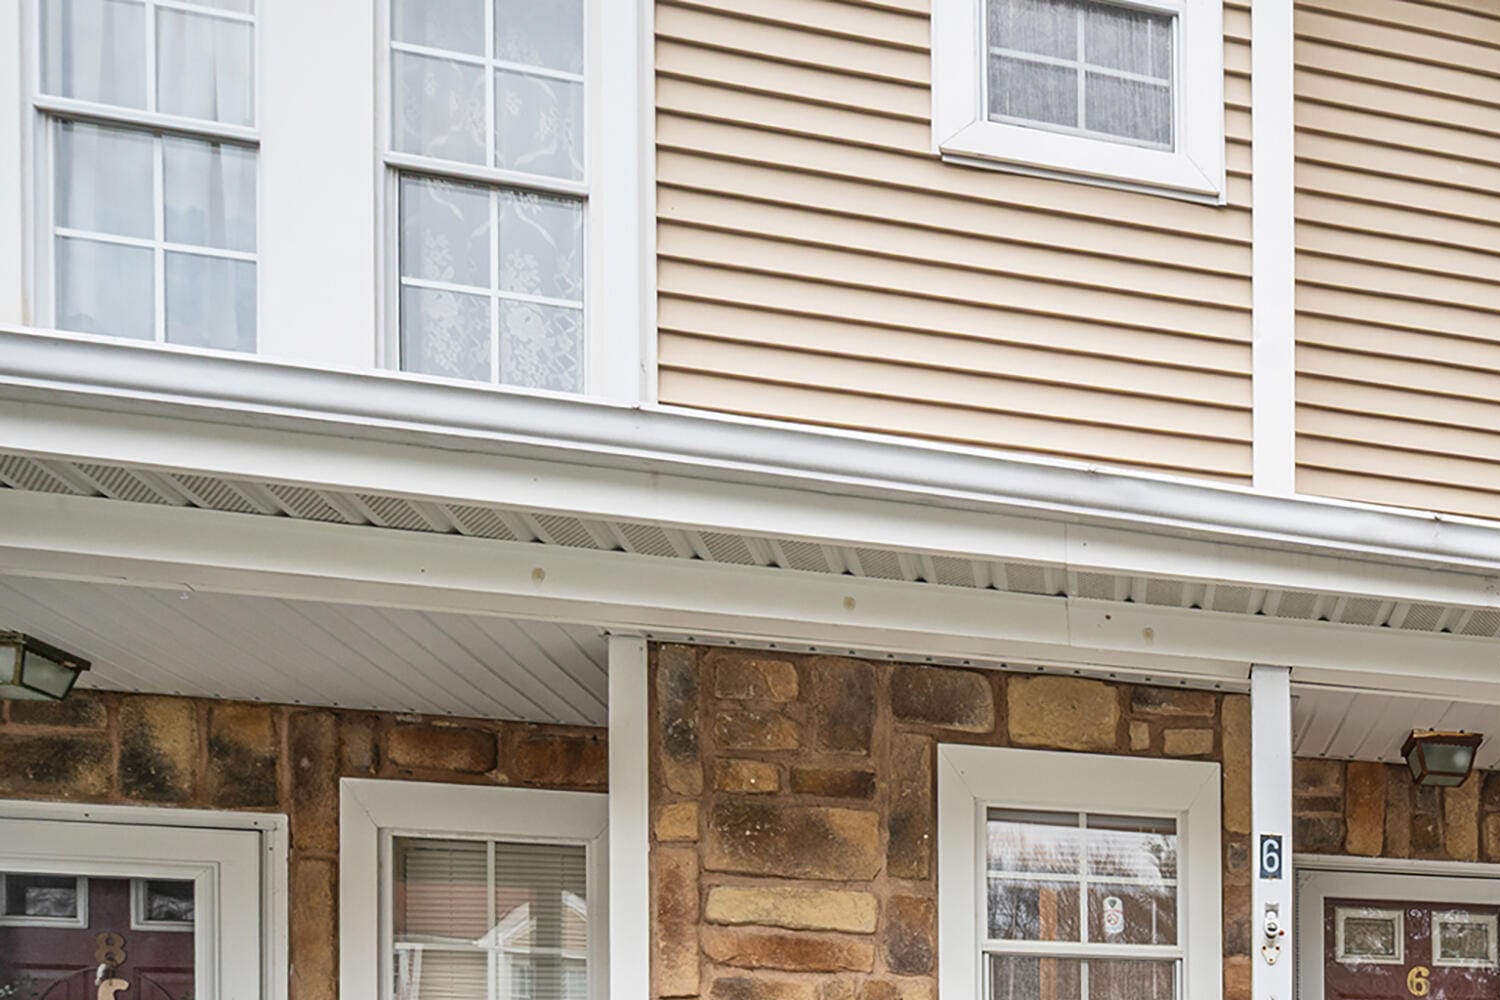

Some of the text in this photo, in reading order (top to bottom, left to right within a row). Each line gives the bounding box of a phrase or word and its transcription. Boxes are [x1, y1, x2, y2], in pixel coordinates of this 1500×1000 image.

[1262, 839, 1280, 873] 6
[95, 932, 126, 967] 8
[1406, 965, 1431, 997] 6
